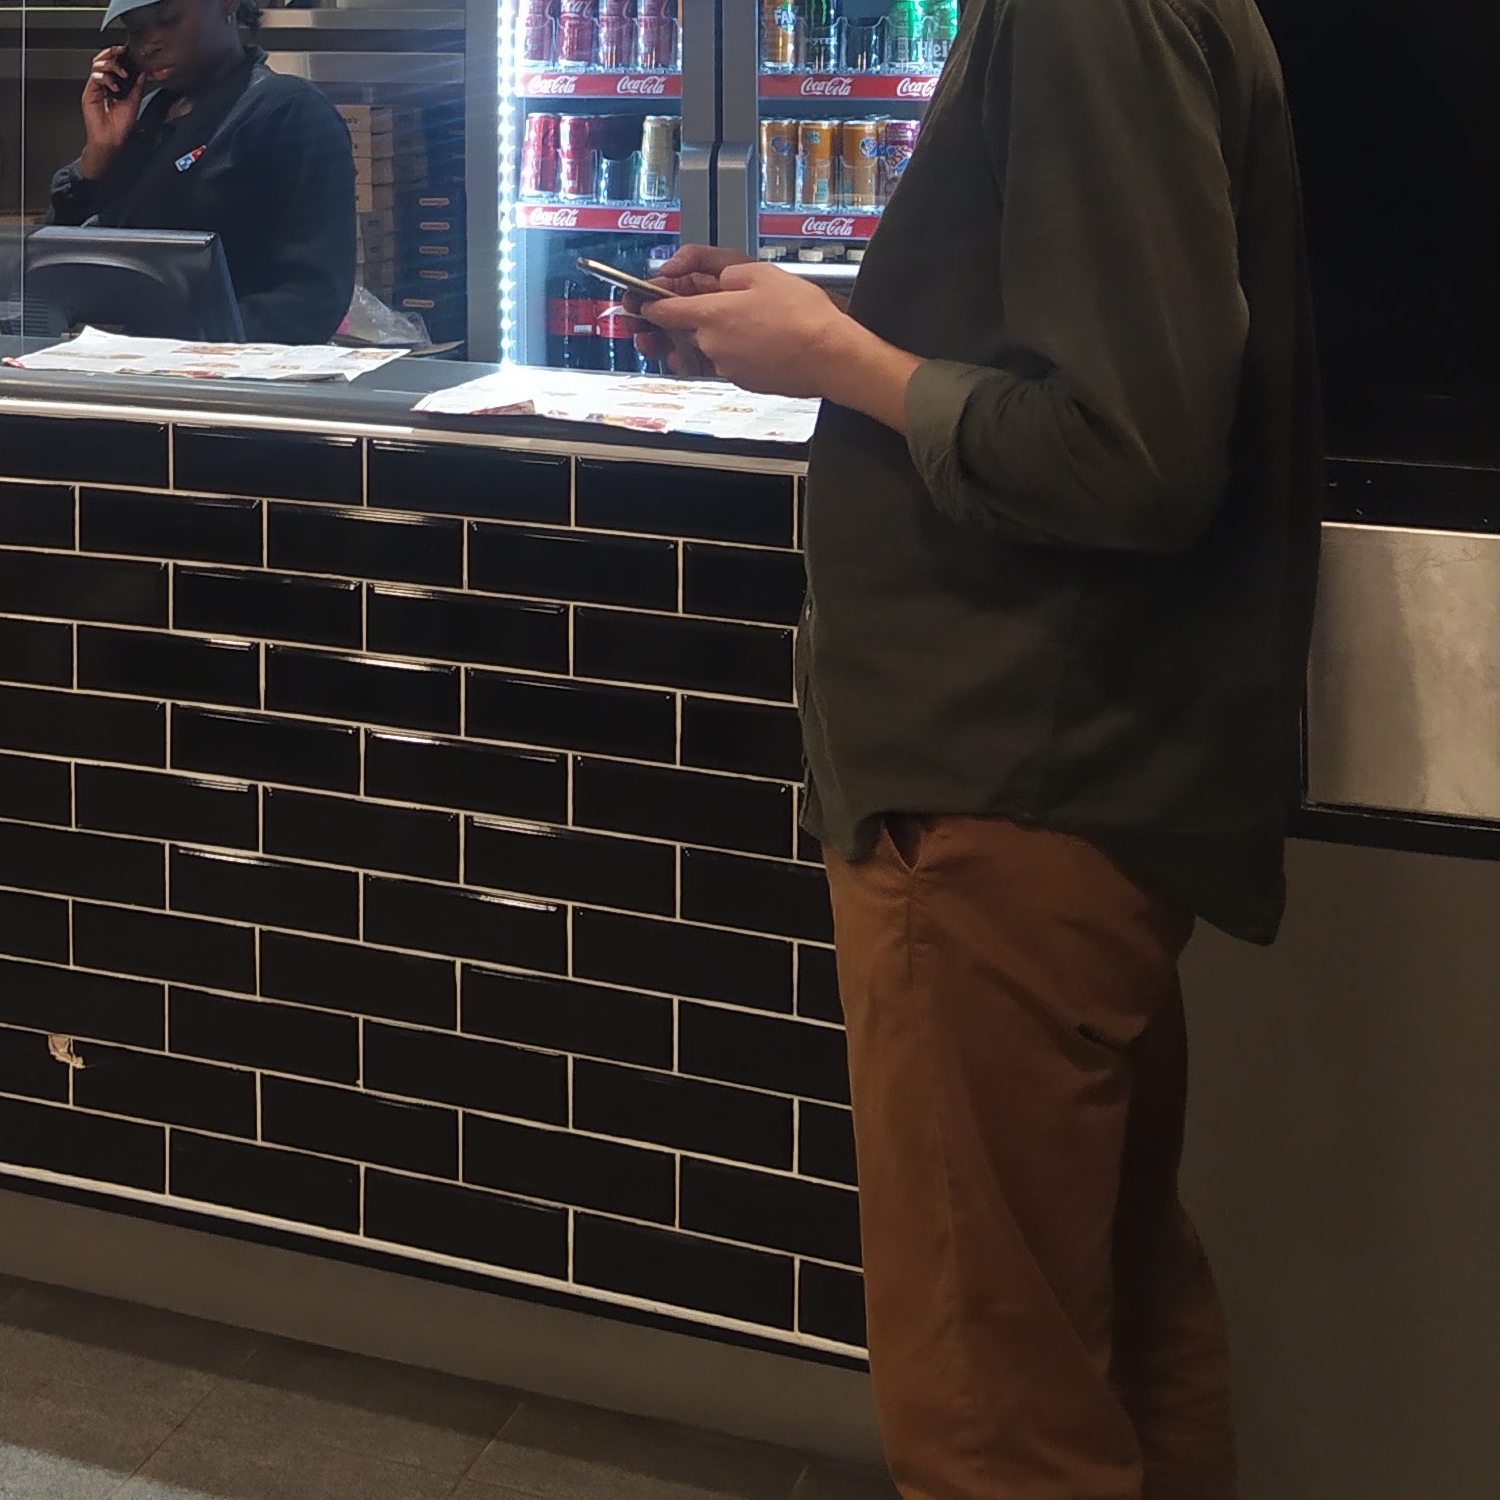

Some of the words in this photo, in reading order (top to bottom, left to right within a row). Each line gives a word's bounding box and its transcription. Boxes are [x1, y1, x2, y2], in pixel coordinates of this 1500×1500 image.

[528, 75, 579, 95] Coca-Cola
[617, 75, 668, 95] Coca-Cola
[800, 77, 854, 96] Coca-Cola
[529, 207, 580, 227] Coca-Cola
[617, 210, 669, 231] Coca-Cola
[801, 216, 855, 236] Coca-Cola
